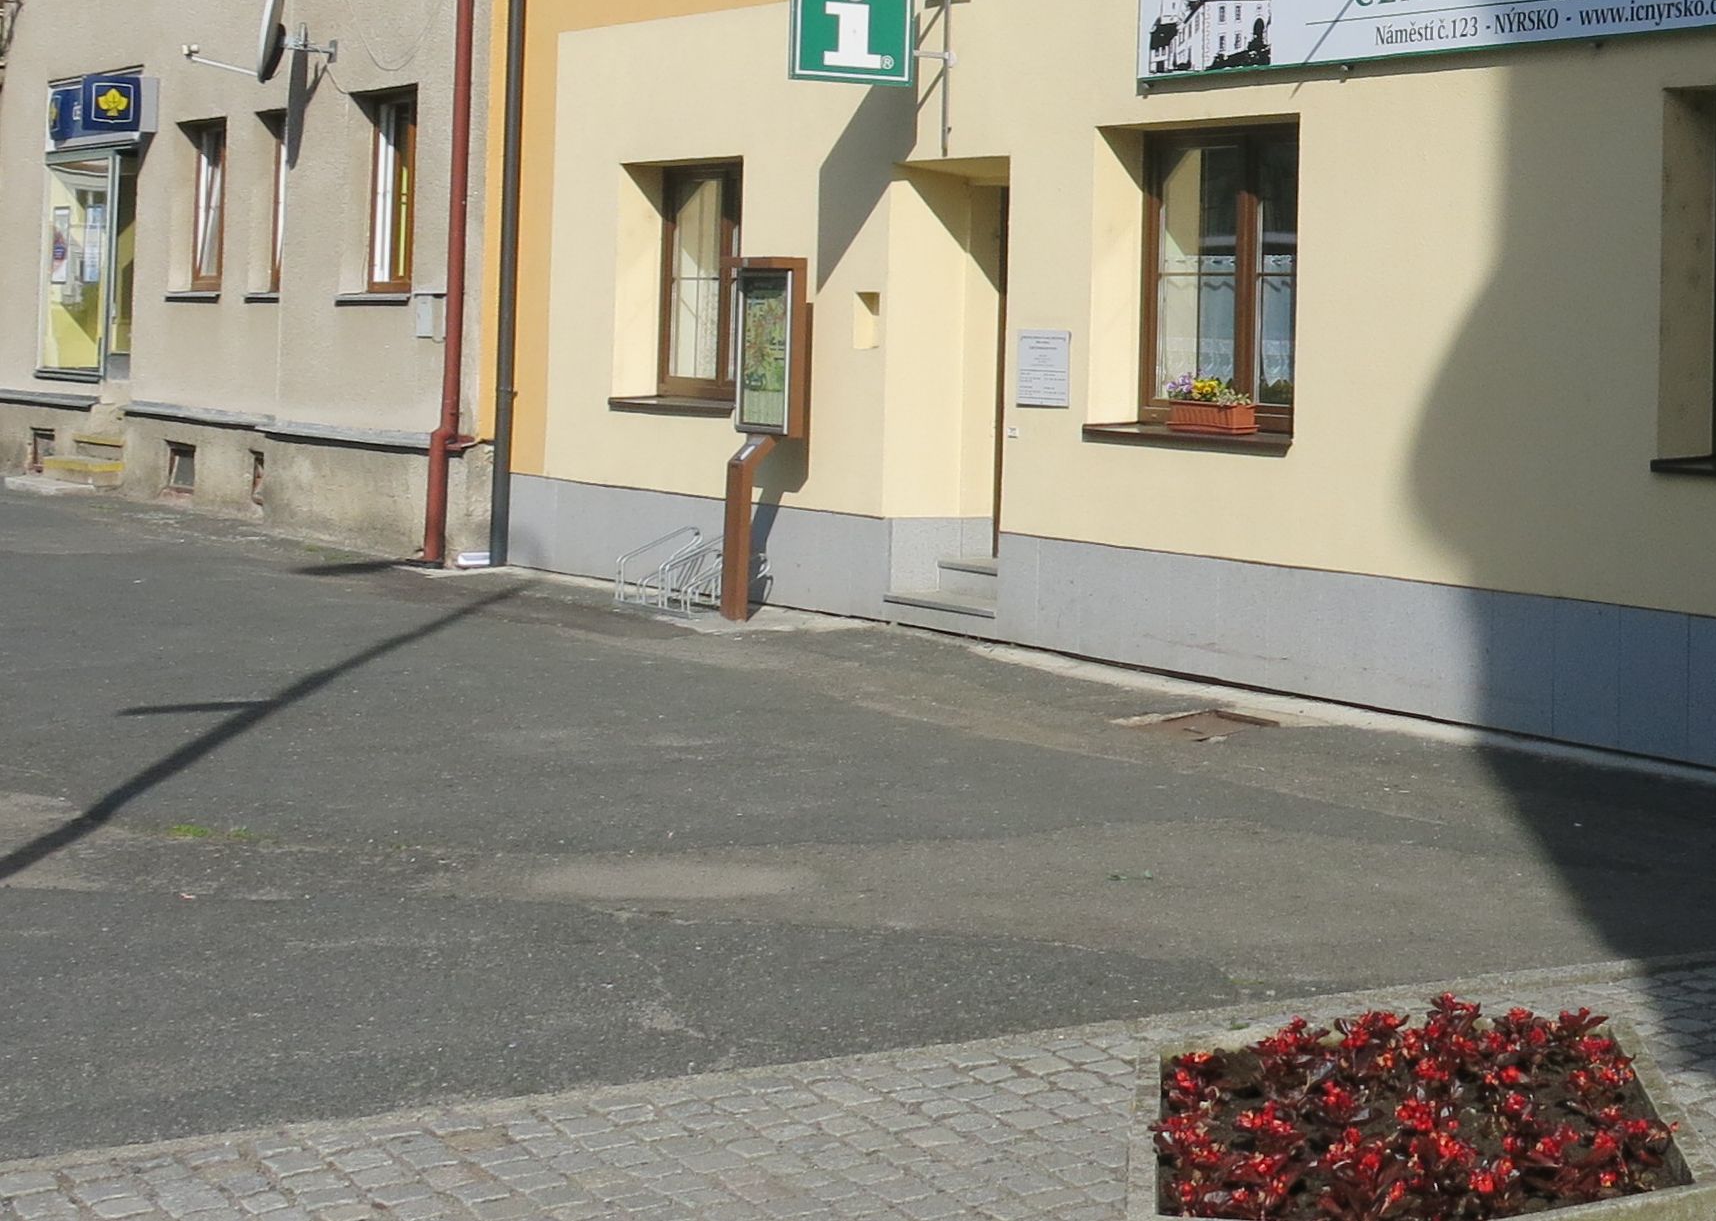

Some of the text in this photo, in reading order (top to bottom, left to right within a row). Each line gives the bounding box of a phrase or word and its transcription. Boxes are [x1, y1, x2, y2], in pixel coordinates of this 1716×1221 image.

[1374, 17, 1435, 46] Náměstí
[1437, 16, 1479, 41] č.123
[1493, 7, 1559, 35] NÝRSKO
